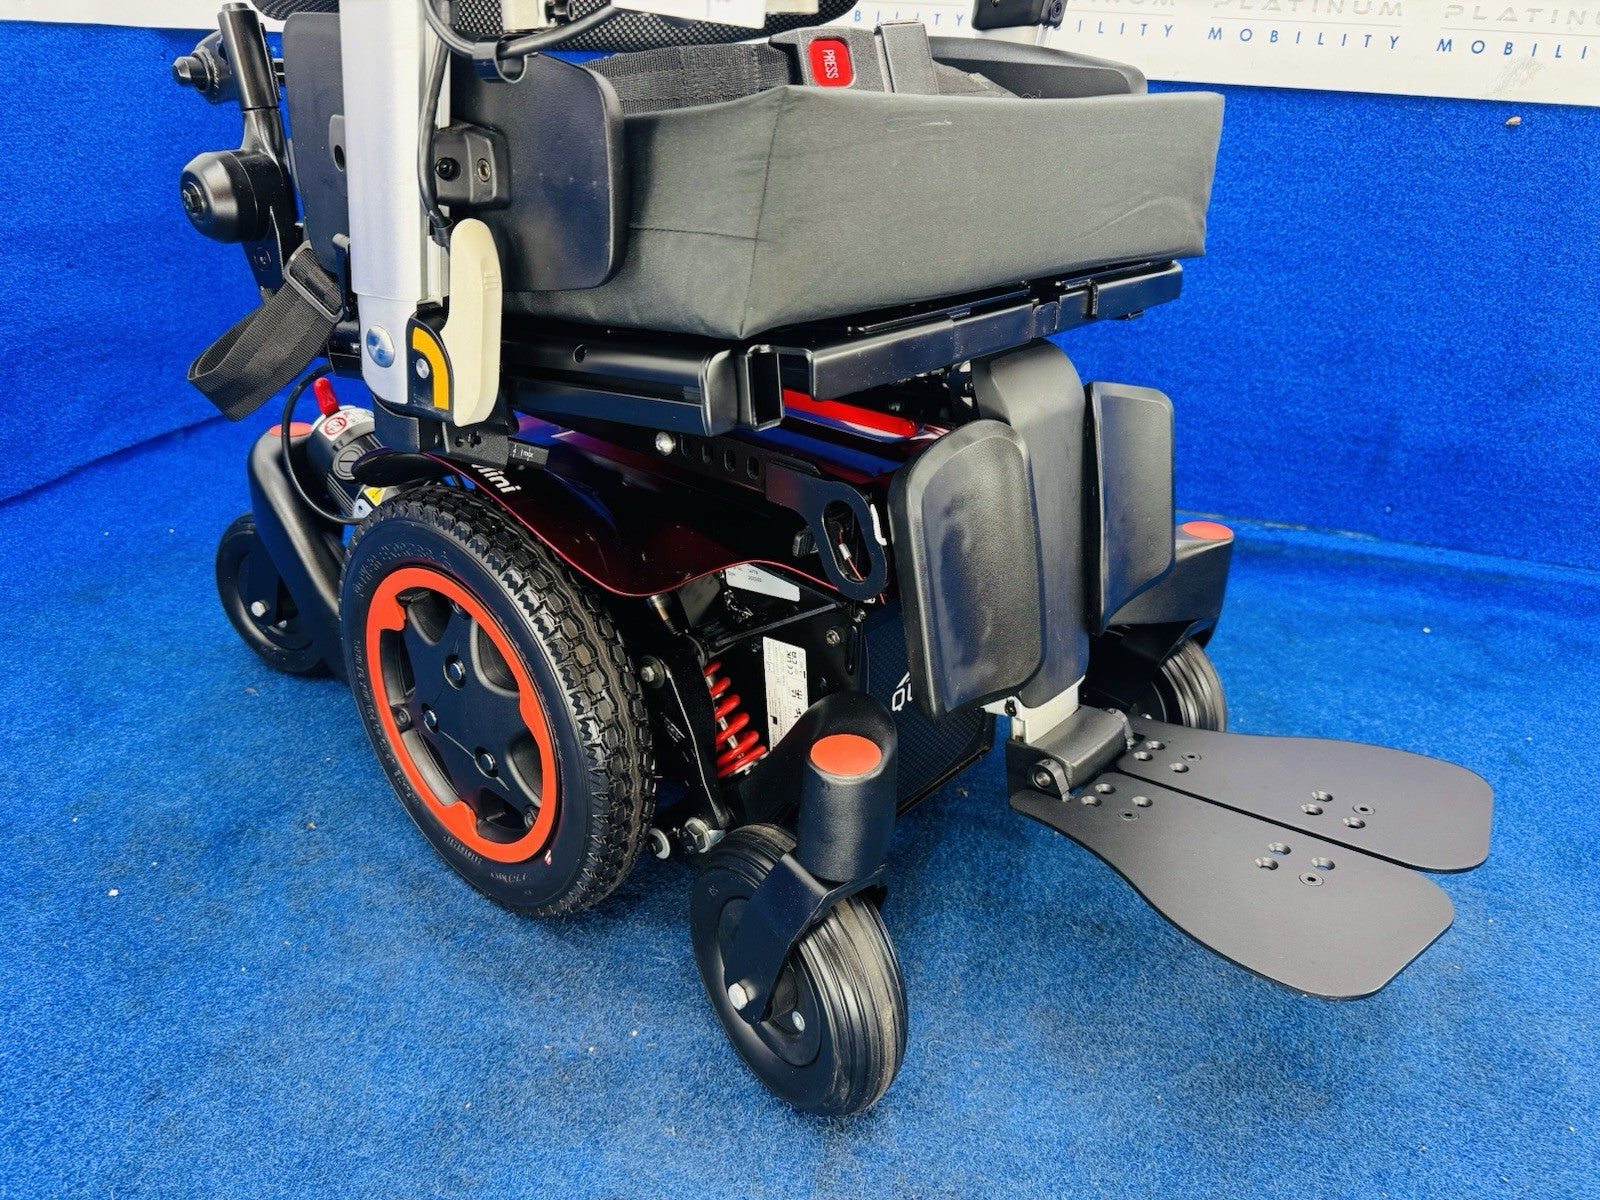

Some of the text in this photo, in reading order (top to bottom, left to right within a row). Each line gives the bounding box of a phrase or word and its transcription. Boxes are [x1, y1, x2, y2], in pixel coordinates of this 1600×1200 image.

[1444, 4, 1600, 26] PLATIN
[1053, 19, 1174, 38] ILITY
[1207, 26, 1400, 50] MOBILITY
[1436, 38, 1588, 60] MOBILI
[822, 49, 839, 79] PRESS
